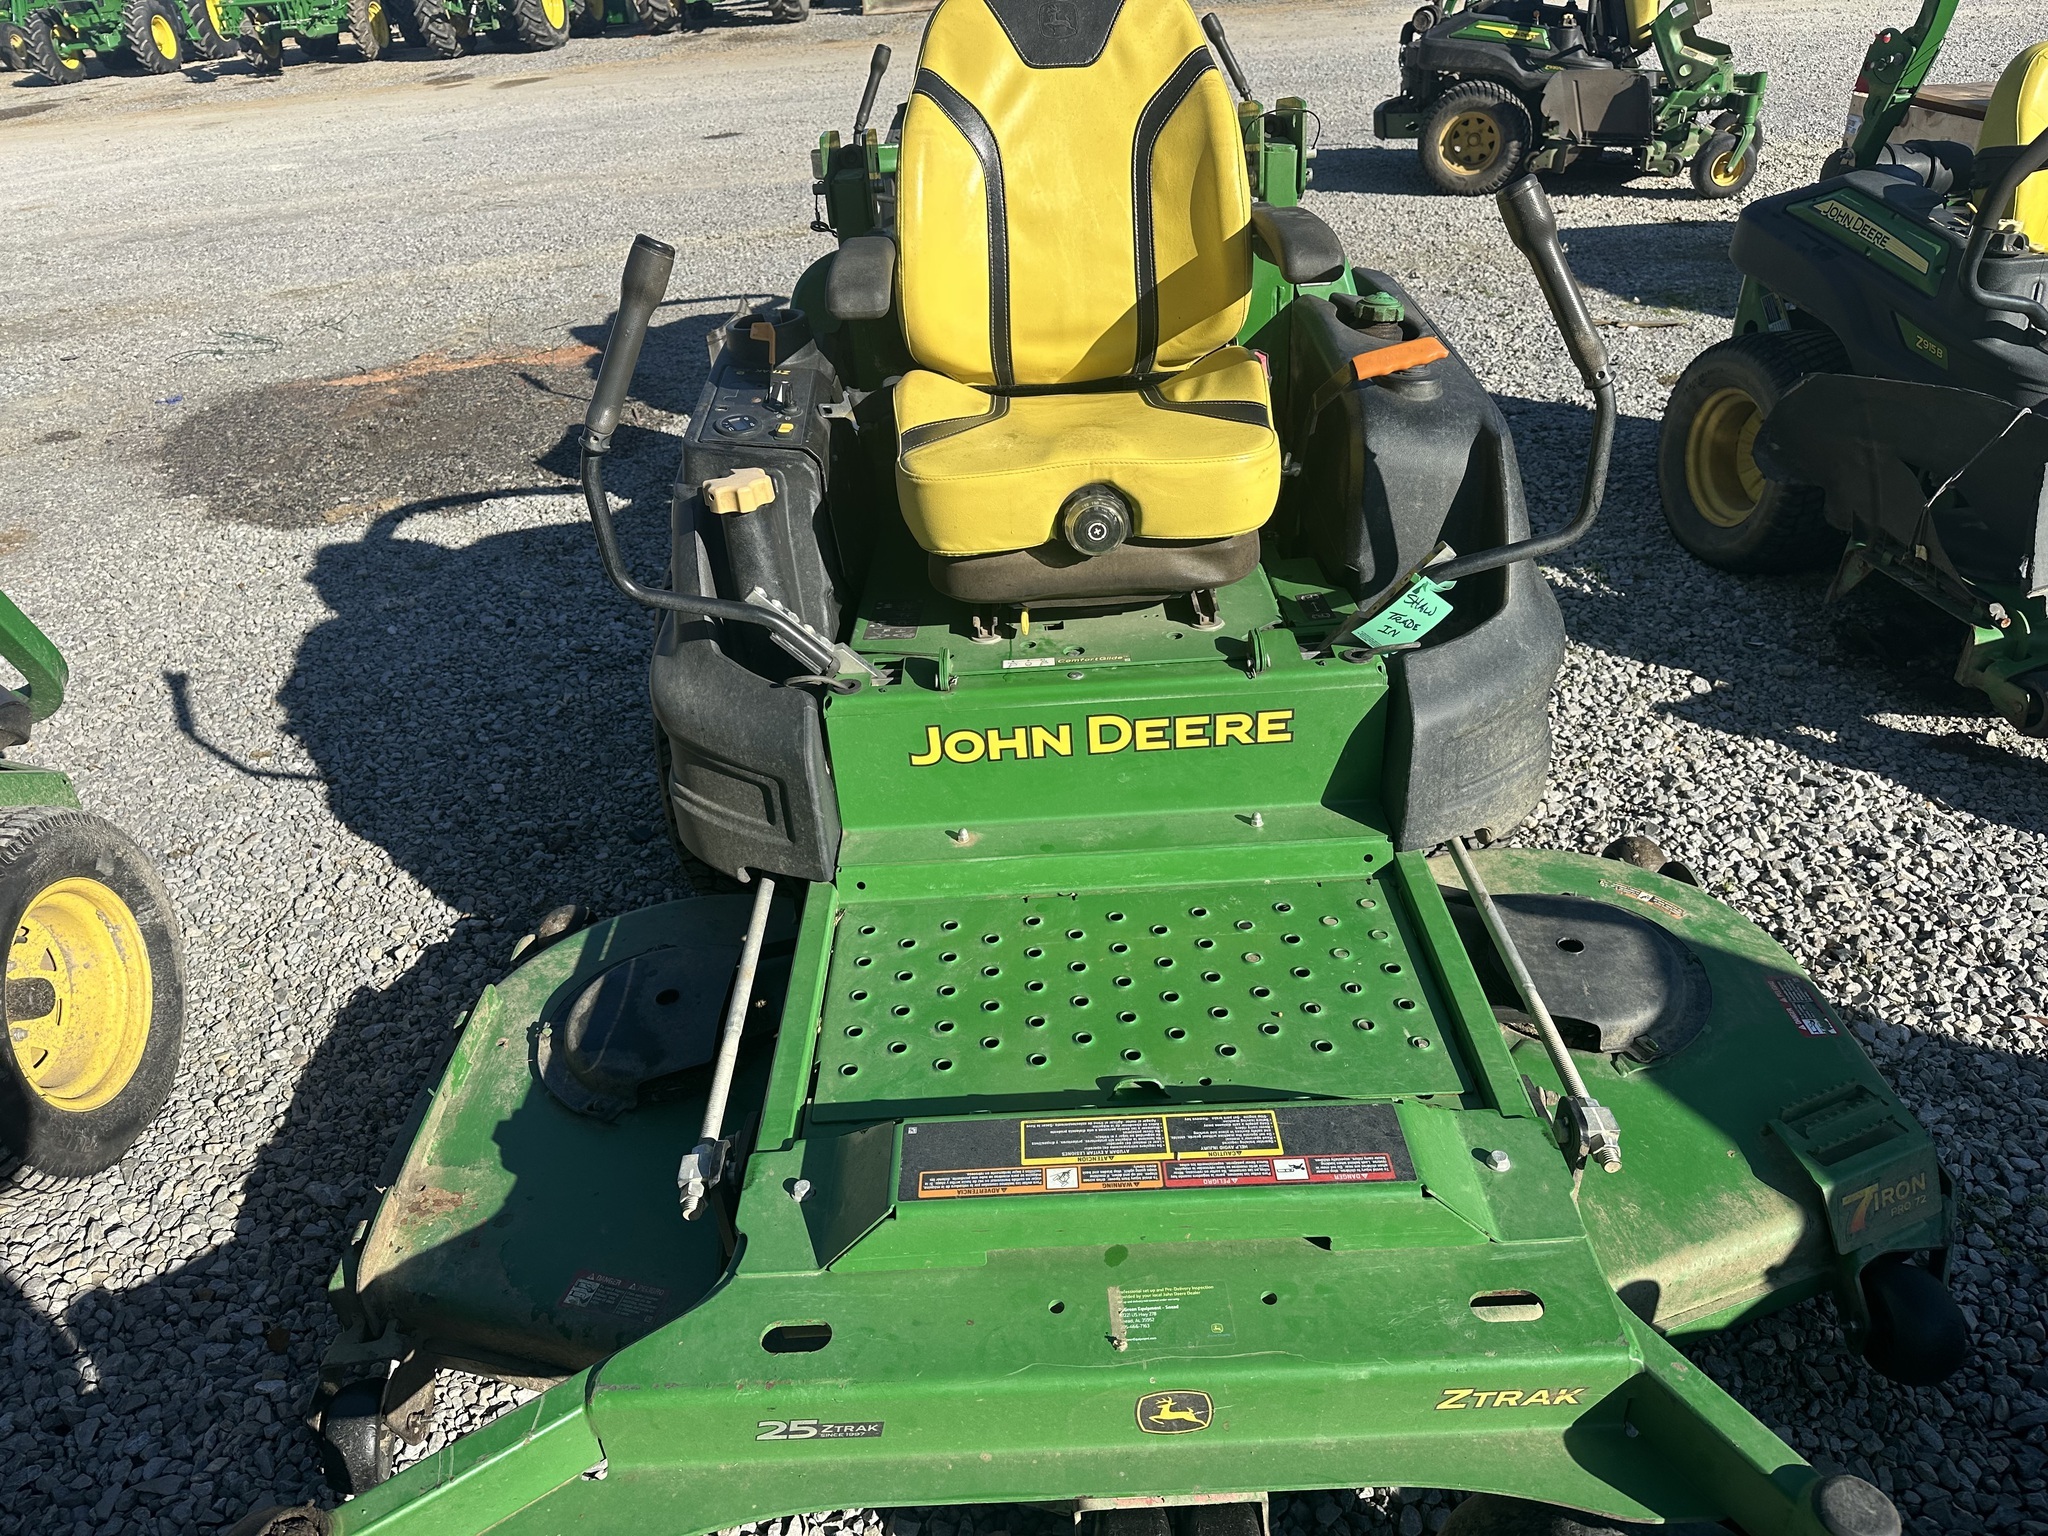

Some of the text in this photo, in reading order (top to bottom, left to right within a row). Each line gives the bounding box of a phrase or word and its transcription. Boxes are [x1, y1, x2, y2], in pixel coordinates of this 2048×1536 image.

[1822, 203, 1890, 248] JOHN DEERE
[1916, 335, 1943, 359] Z915B
[1378, 624, 1400, 638] IN
[1388, 612, 1421, 631] TRADE
[908, 708, 1295, 768] JOHN DEERE
[1891, 1194, 1927, 1217] PRO 72
[1434, 1388, 1588, 1410] ZTRAK
[756, 1419, 878, 1440] 25 ZTRAK
